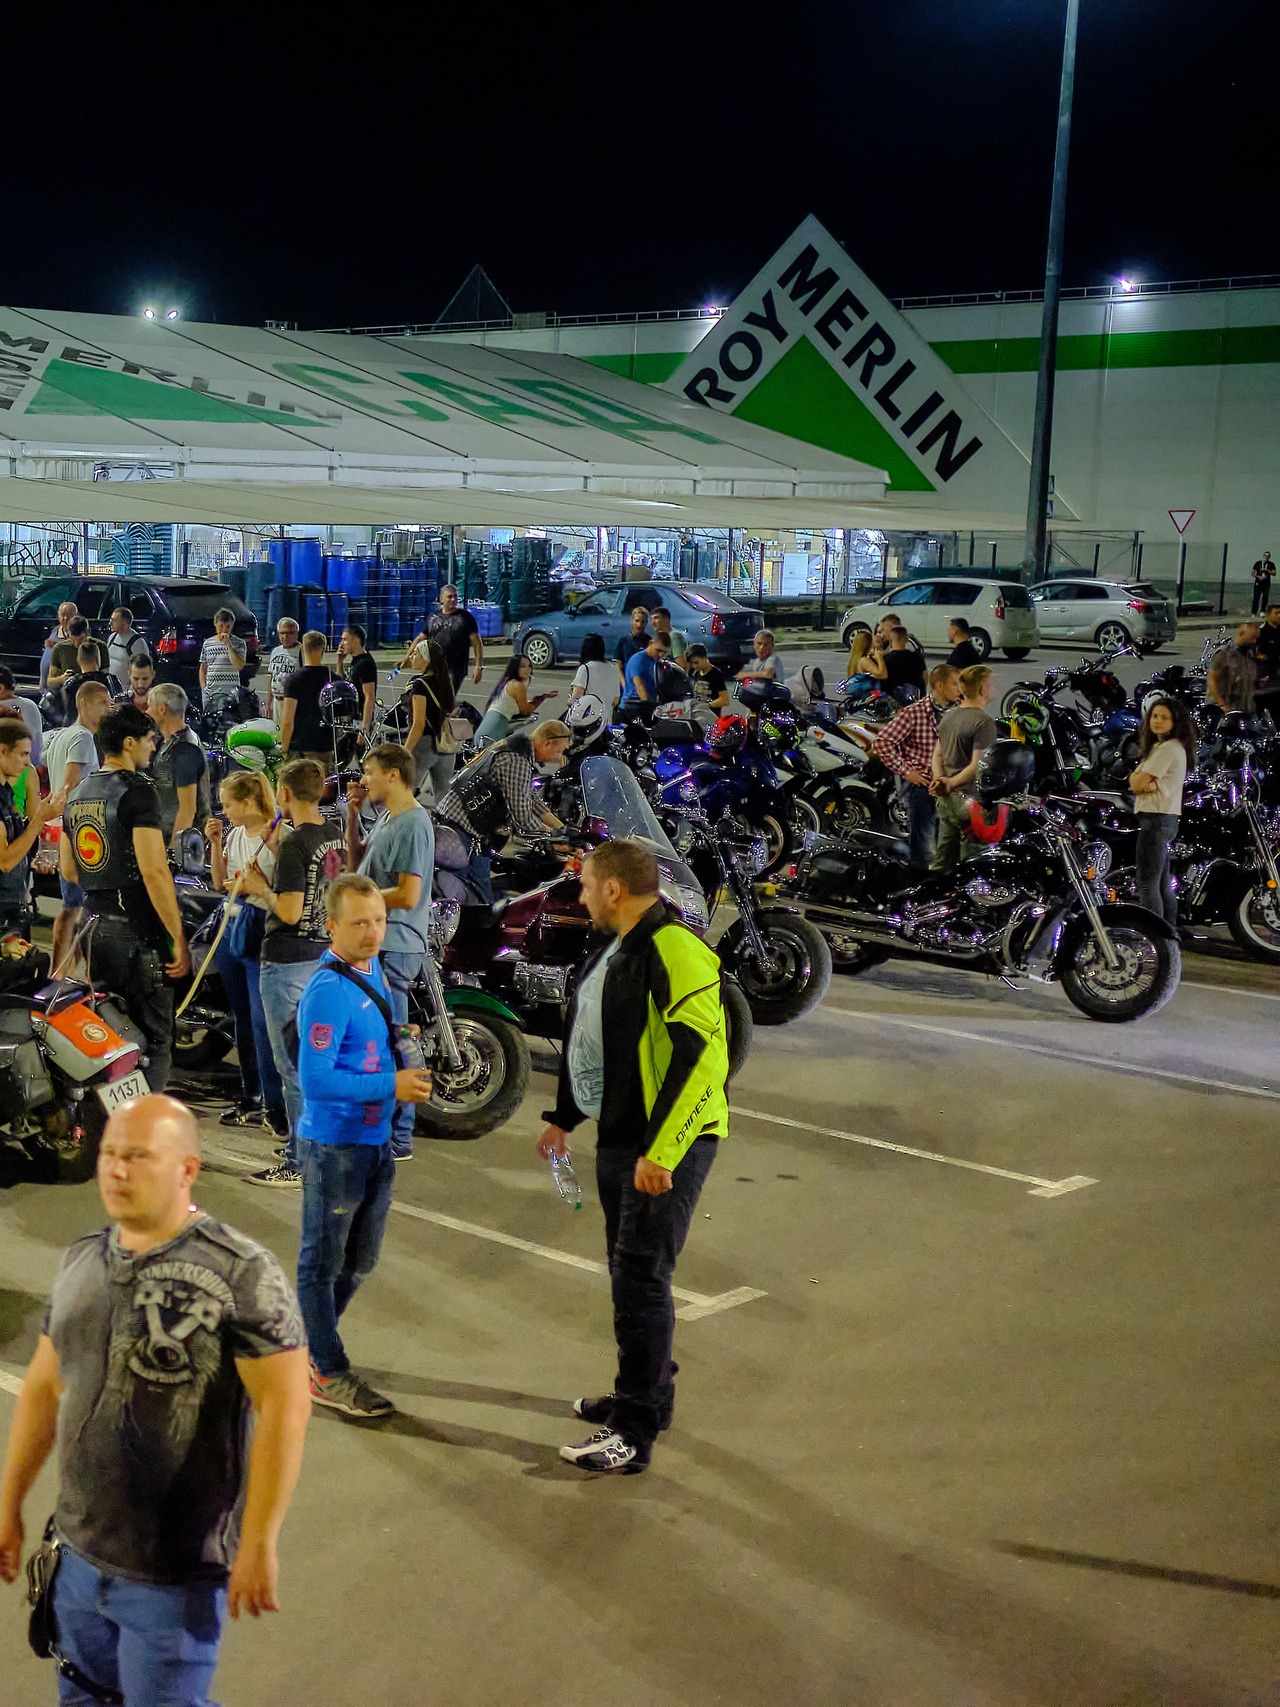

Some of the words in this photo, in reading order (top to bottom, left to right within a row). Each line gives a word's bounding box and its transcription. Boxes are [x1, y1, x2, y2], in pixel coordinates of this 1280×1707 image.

[683, 289, 789, 407] ROY
[776, 244, 983, 482] MERLIN
[109, 1078, 140, 1103] 1137
[675, 1085, 714, 1144] DAINESE
